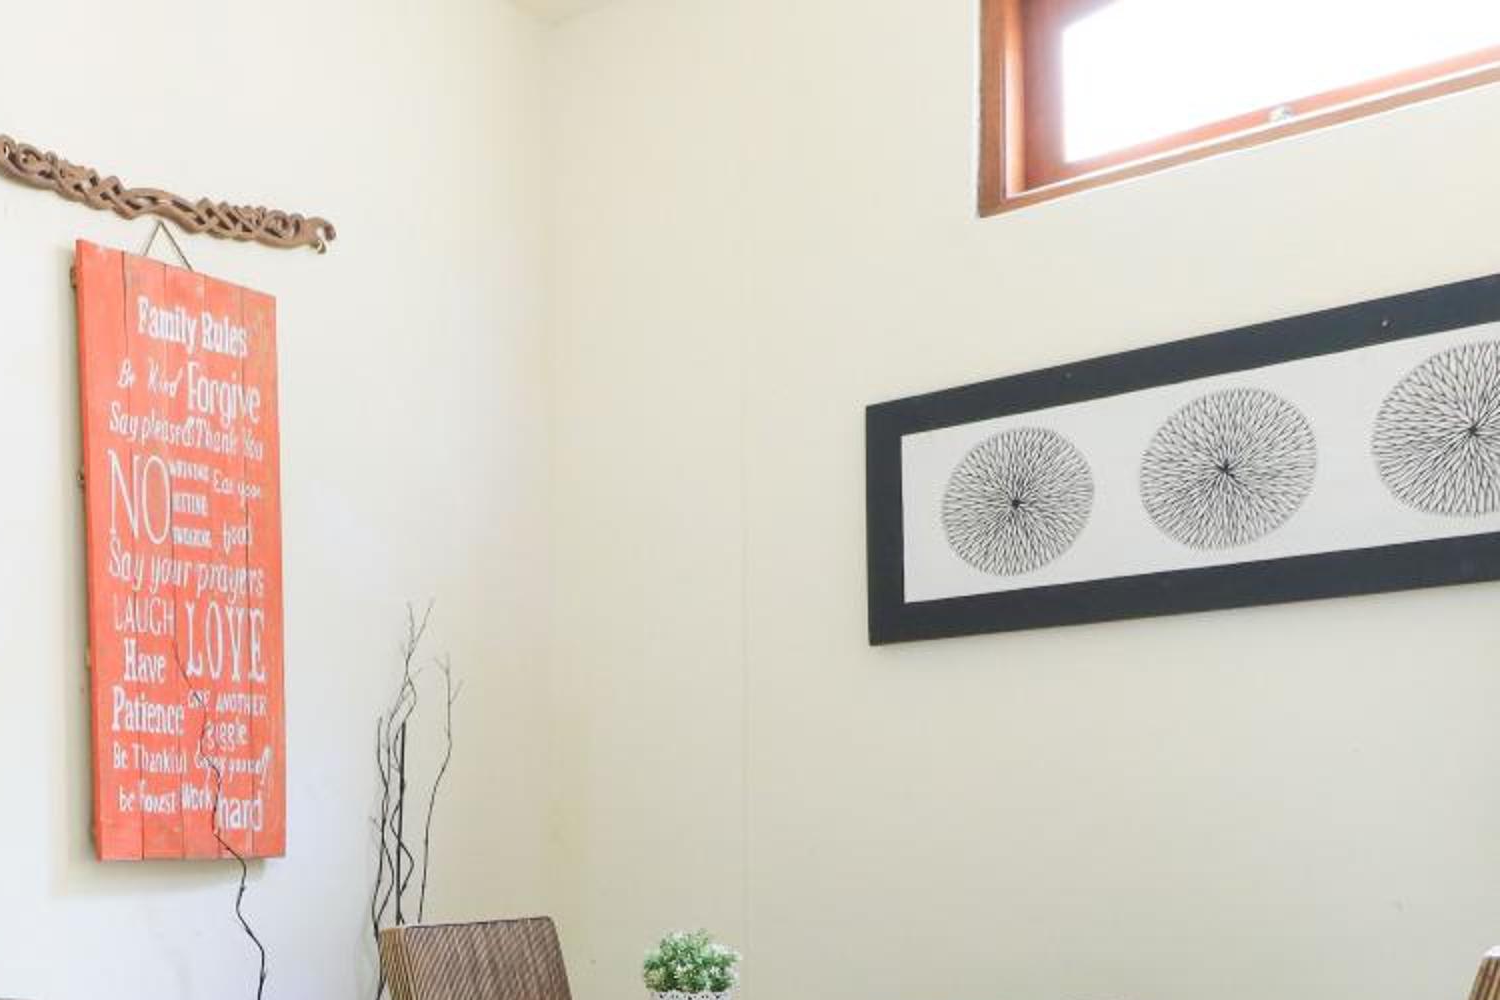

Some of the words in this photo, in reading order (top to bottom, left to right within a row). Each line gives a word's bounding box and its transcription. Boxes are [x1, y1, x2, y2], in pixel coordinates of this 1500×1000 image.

[137, 296, 197, 353] Family
[202, 312, 248, 357] Rules
[109, 401, 137, 443] Say
[187, 361, 261, 428] Forgive
[107, 449, 170, 544] NO
[109, 534, 144, 592] Say
[150, 555, 193, 594] your
[196, 561, 265, 605] prayers
[113, 593, 174, 638] LAUGH
[185, 600, 267, 683] LOVE
[124, 637, 166, 684] Have
[112, 684, 185, 736] Patience
[216, 691, 267, 717] ANOTHER
